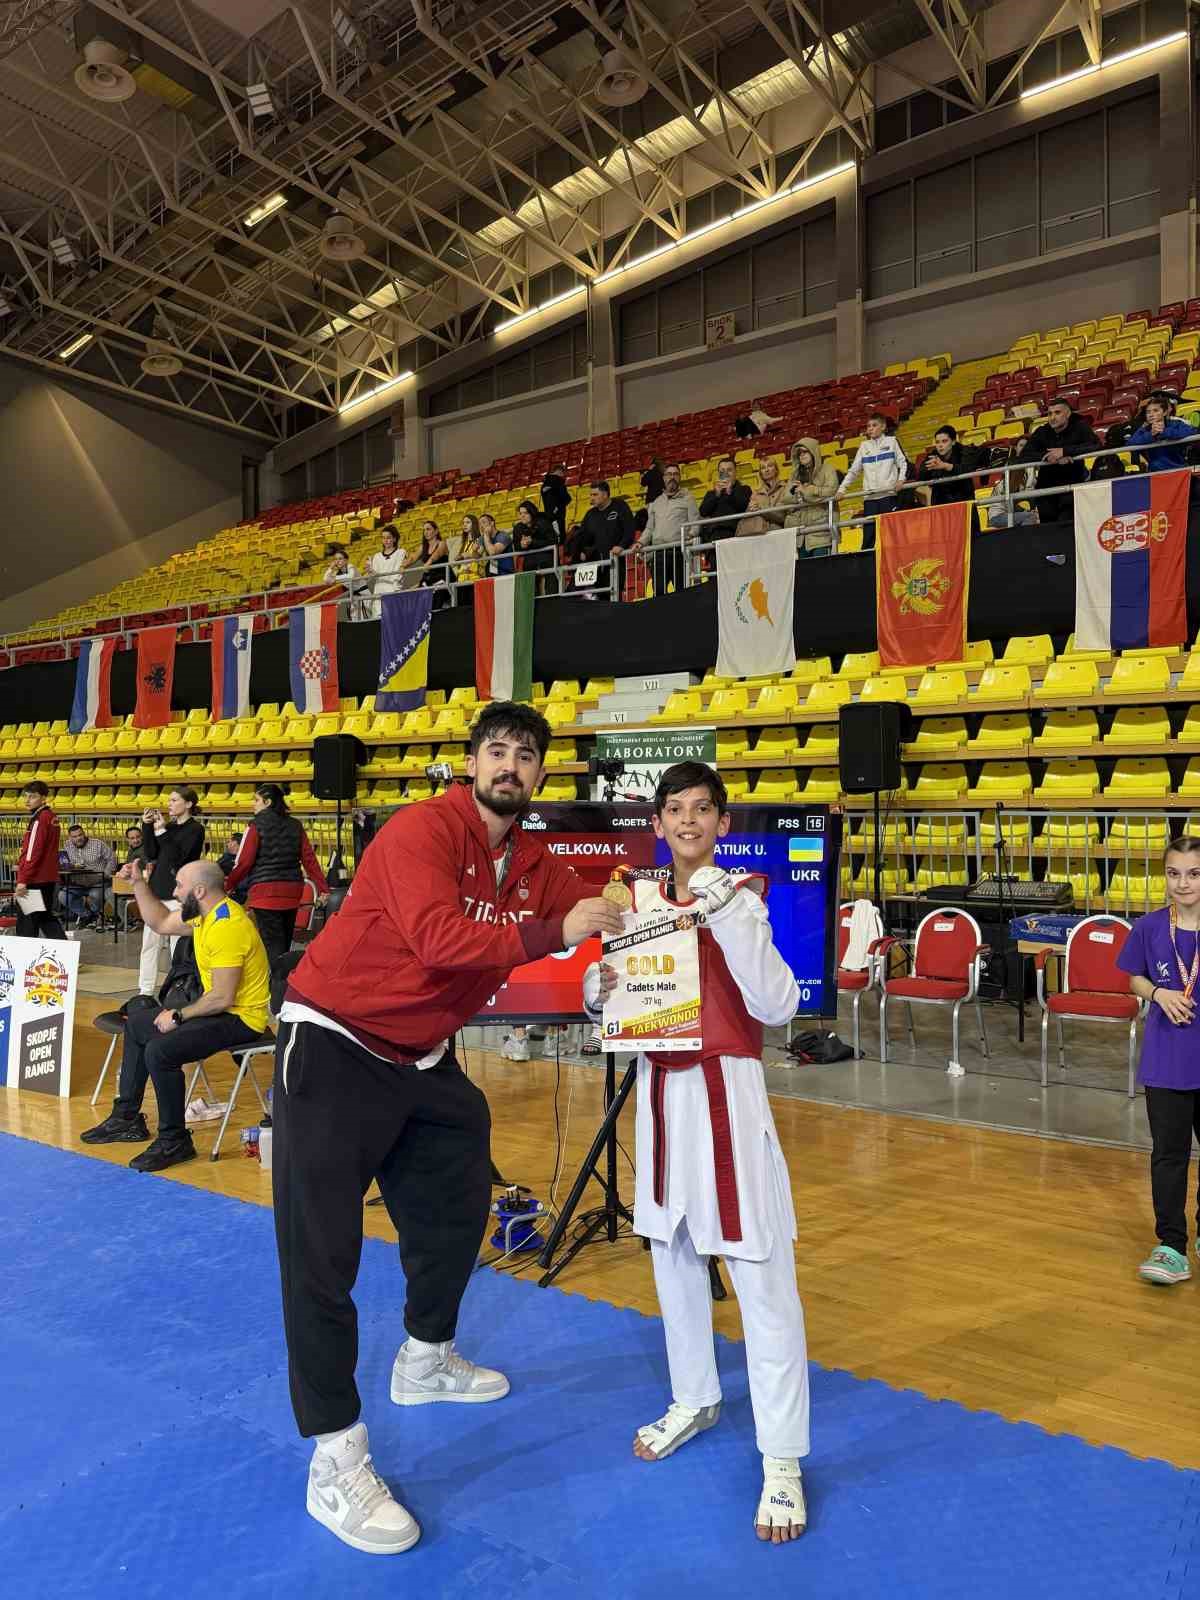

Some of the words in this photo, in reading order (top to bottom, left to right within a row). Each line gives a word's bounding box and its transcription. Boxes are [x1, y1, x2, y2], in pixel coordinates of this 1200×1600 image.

[716, 326, 726, 339] 2
[578, 571, 594, 582] M2
[615, 713, 625, 722] VI
[606, 745, 705, 759] LABORATORY
[522, 820, 547, 830] Daedo
[612, 818, 647, 827] CADETS
[778, 819, 800, 829] PSS
[809, 819, 822, 828] 15
[548, 843, 611, 855] VELKOVA
[615, 843, 628, 855] K.
[754, 844, 767, 856] U.
[791, 869, 820, 881] UKR
[609, 937, 633, 951] SKOPJE
[633, 930, 650, 943] OPEN
[651, 923, 674, 937] RAMUS
[626, 954, 675, 976] GOLD
[626, 982, 655, 992] Cadets
[656, 981, 677, 991] Male
[653, 996, 662, 1006] kg
[607, 1020, 620, 1035] G1
[631, 1007, 699, 1036] TAEKWONDO
[26, 1026, 58, 1047] SKOPJE
[29, 1044, 52, 1062] OPEN
[24, 1059, 56, 1079] RAMUS
[769, 1495, 795, 1509] Daedo
